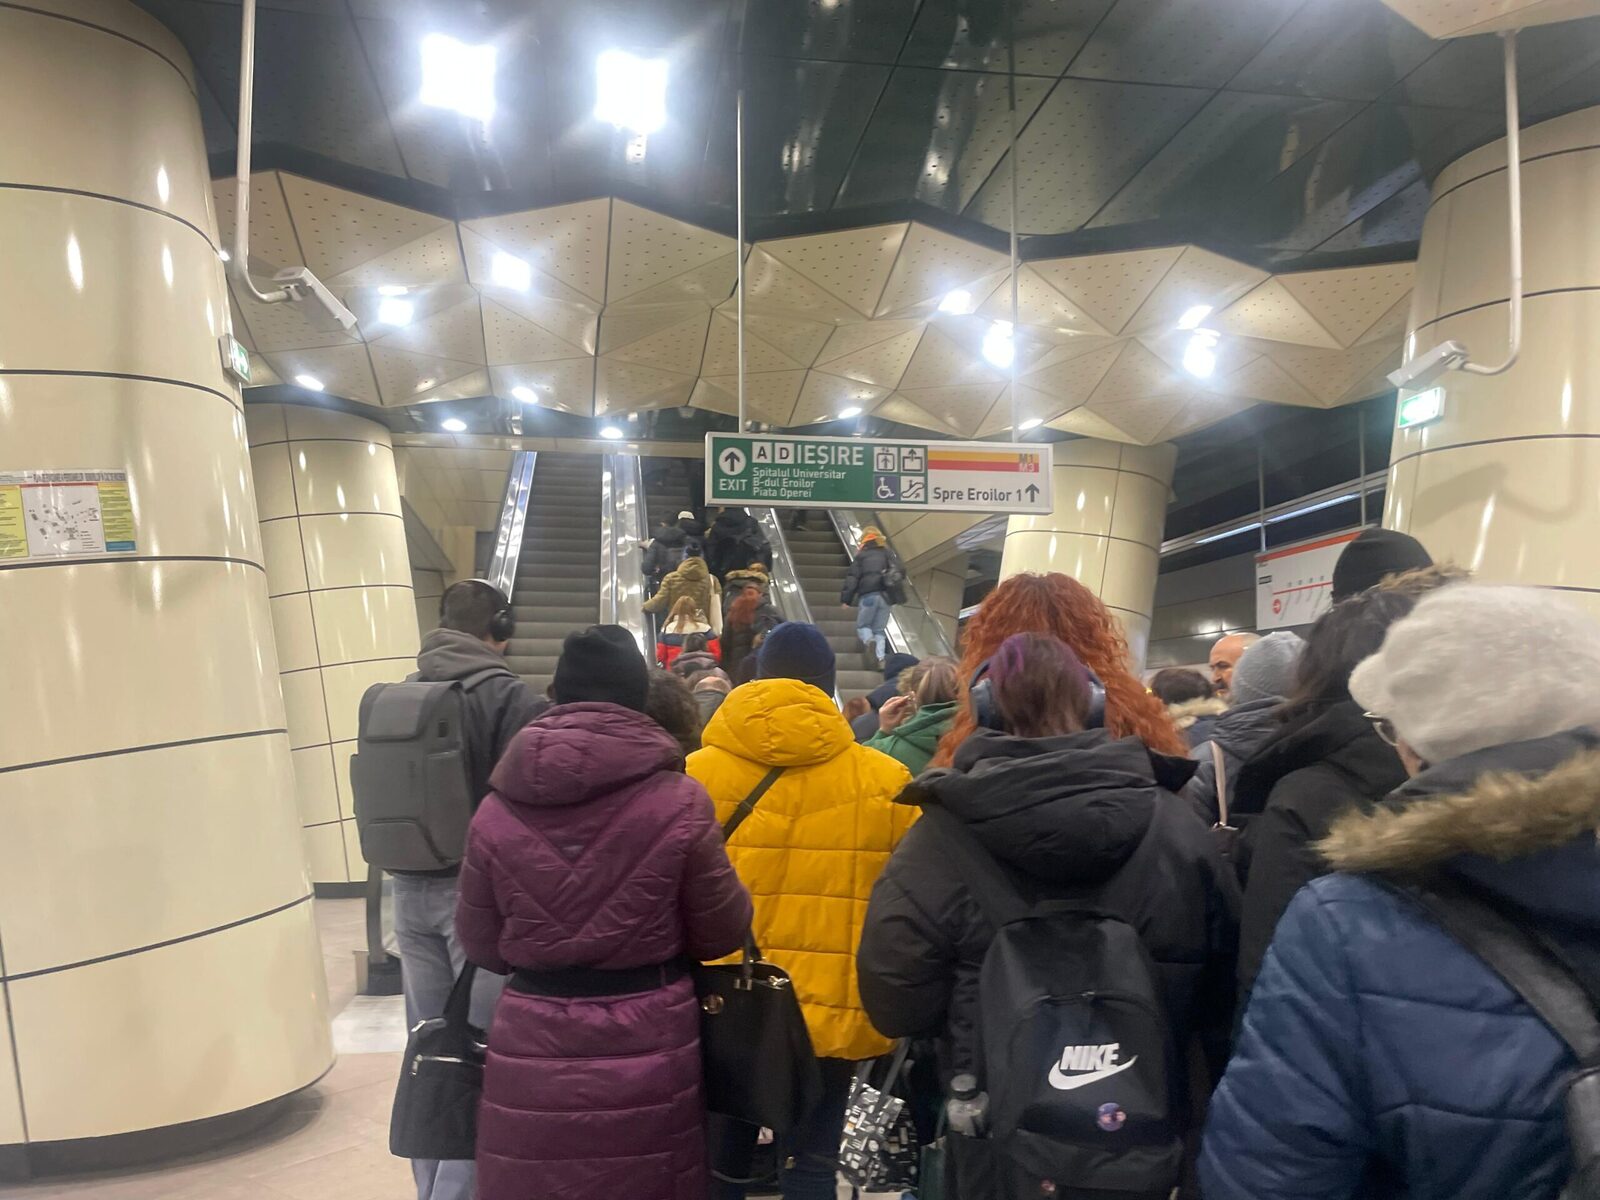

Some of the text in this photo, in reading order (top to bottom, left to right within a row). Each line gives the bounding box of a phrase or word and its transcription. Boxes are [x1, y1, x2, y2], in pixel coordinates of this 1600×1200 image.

[757, 446, 768, 460] A
[779, 446, 790, 460] D
[1018, 453, 1034, 463] M1
[752, 467, 847, 481] Spitalul Universitar
[1018, 463, 1035, 472] M3
[719, 478, 748, 491] EXIT
[753, 478, 816, 488] B-dul Eroilor
[780, 487, 812, 499] Operei
[933, 487, 1022, 501] Spre Eroilor 1
[1060, 1043, 1120, 1072] NIKE
